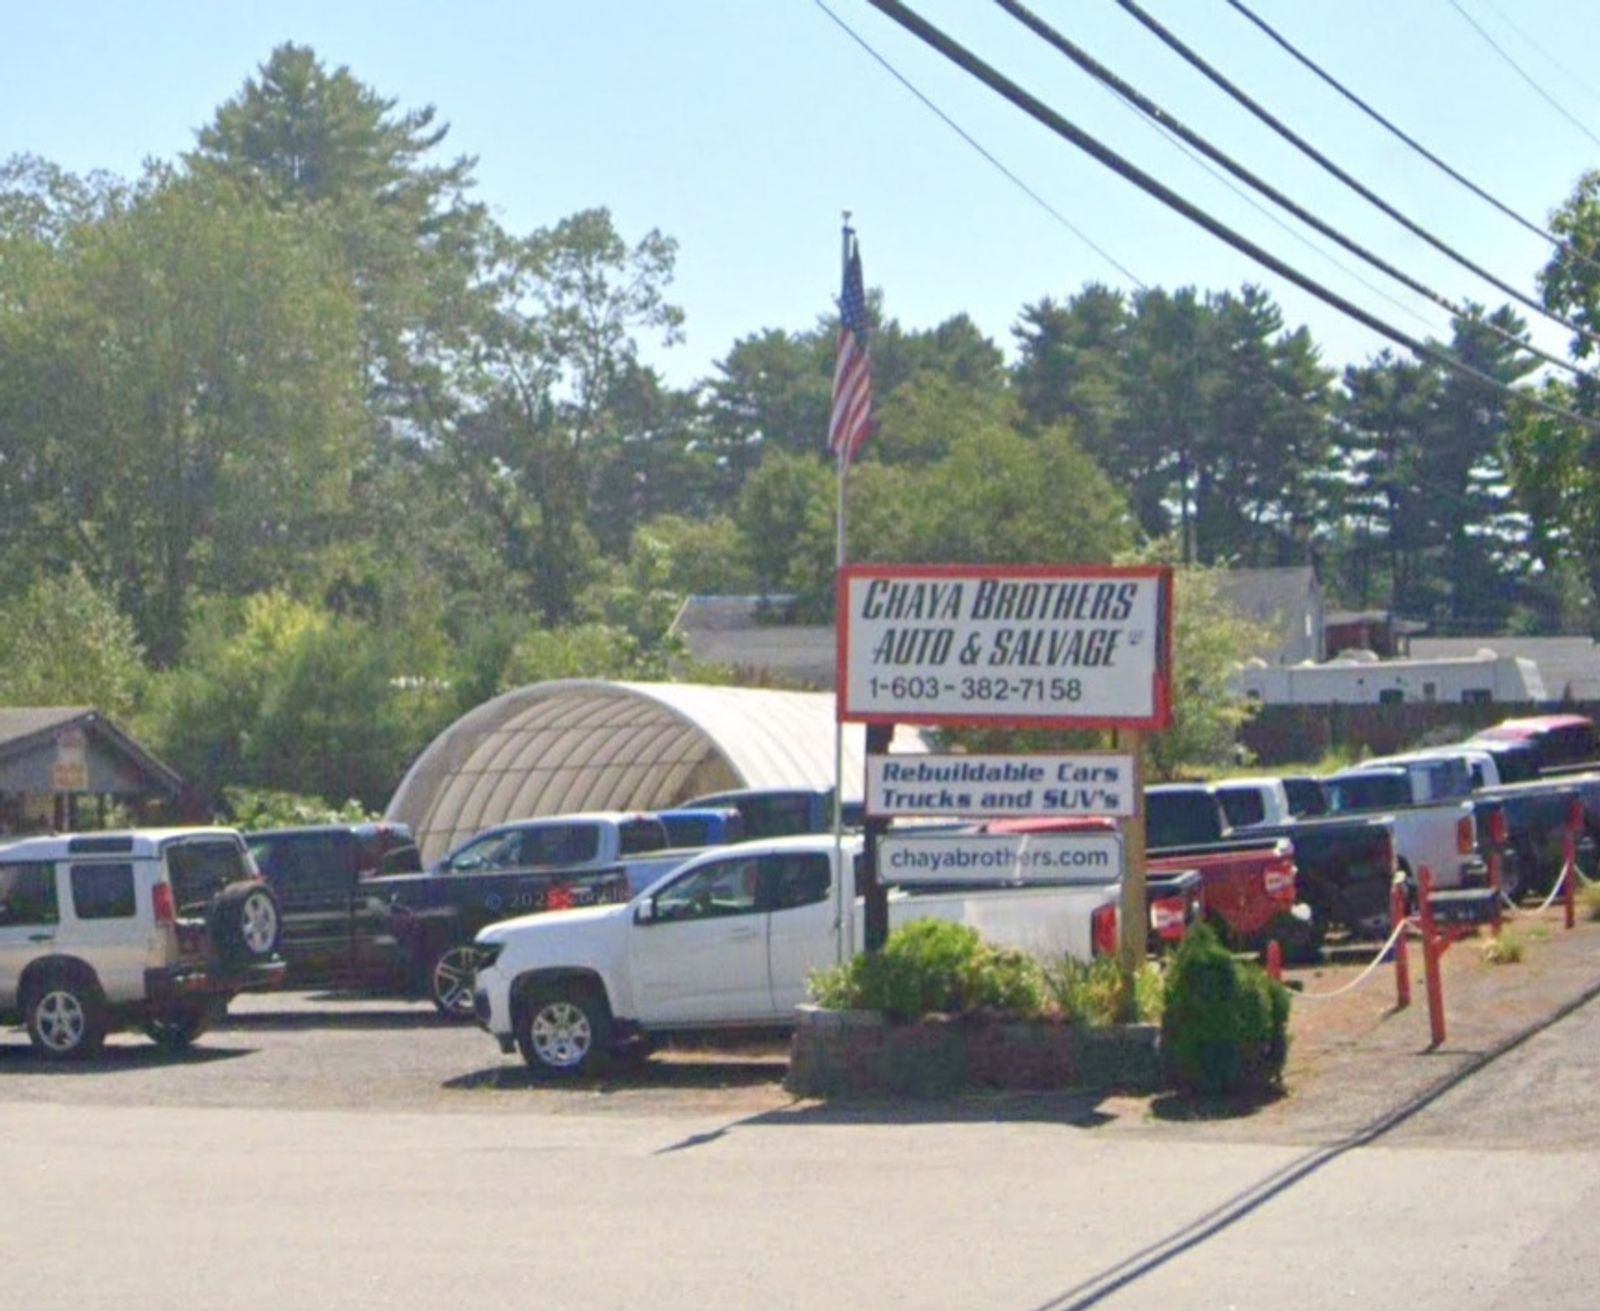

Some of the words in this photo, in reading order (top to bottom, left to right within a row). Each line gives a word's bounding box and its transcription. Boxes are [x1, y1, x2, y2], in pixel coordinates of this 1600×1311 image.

[861, 579, 964, 620] CHAYA
[971, 579, 1138, 621] BROTHERS
[873, 628, 955, 665] AUTO
[959, 632, 981, 666] &
[988, 629, 1122, 667] SALVAGE
[882, 762, 1045, 783] Rebuildable
[1057, 762, 1119, 783] Cars
[882, 789, 972, 809] Trucks
[980, 789, 1032, 809] and
[1042, 789, 1119, 809] SUV's
[890, 847, 1109, 871] chayabrothers.com
